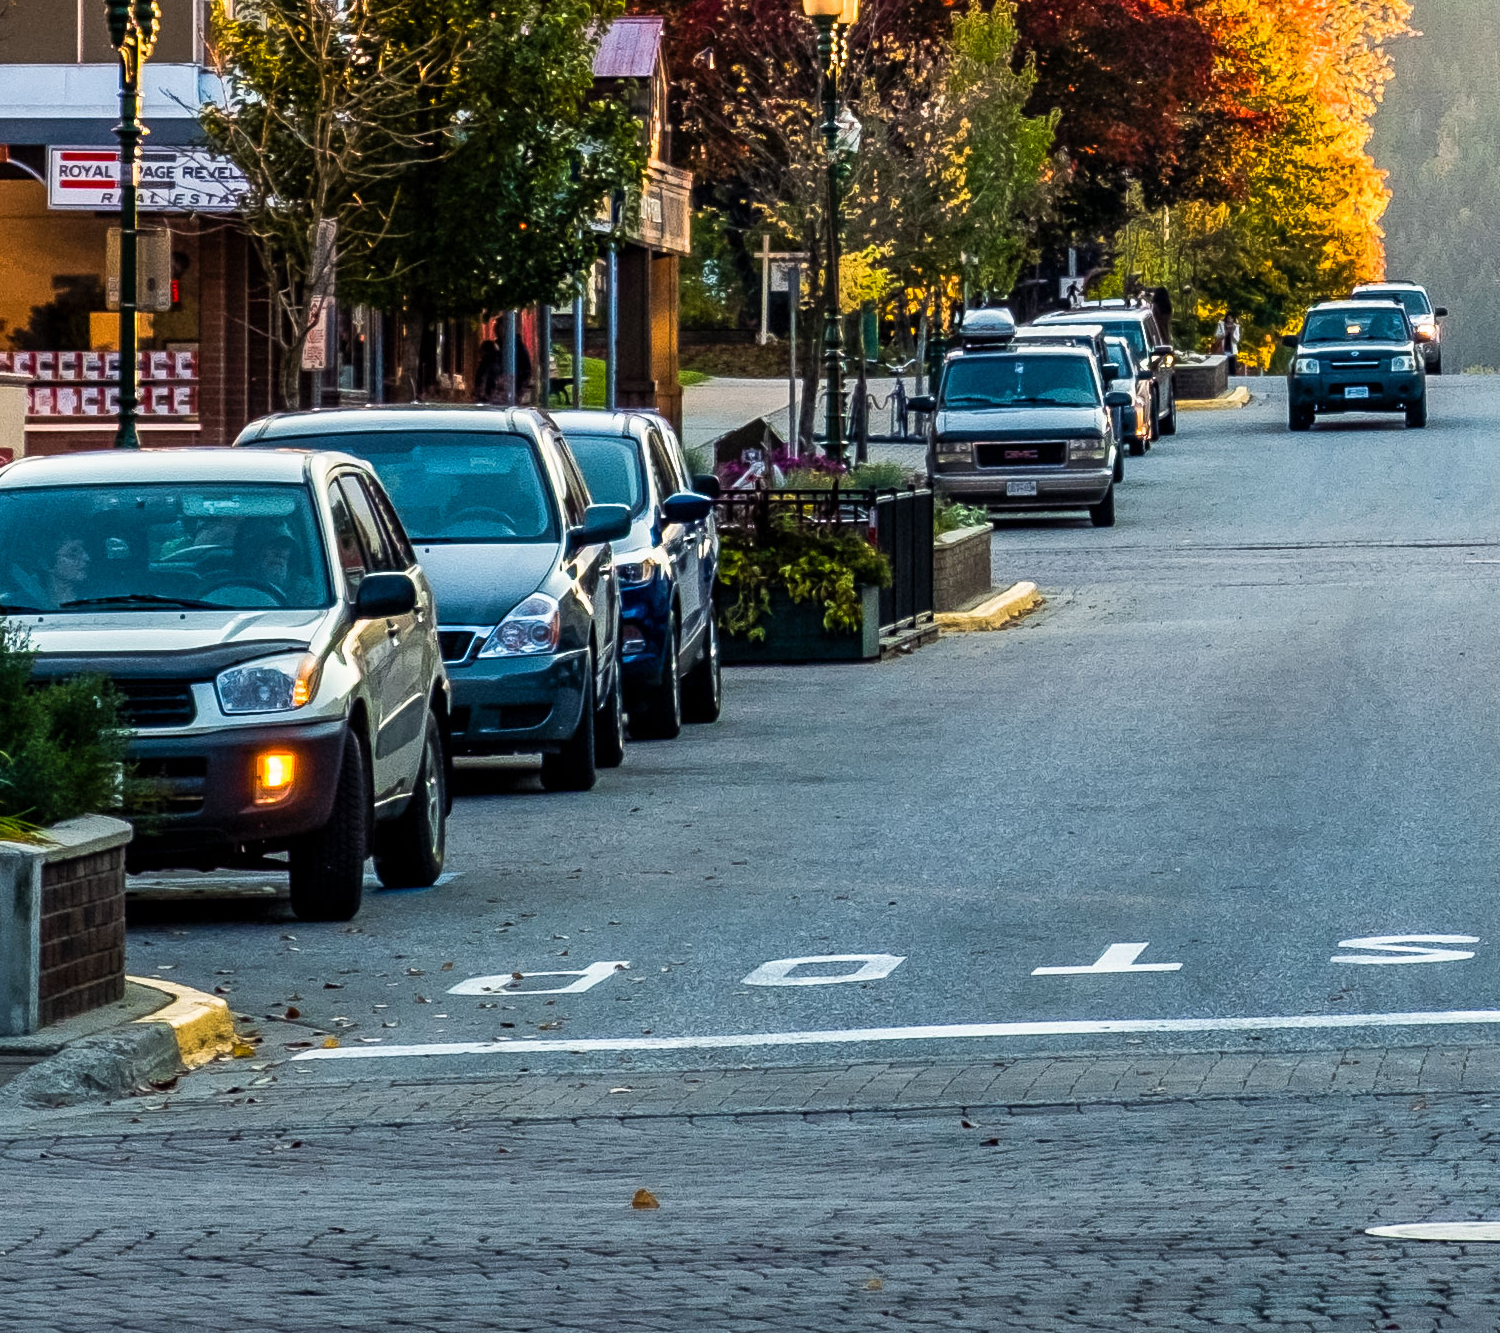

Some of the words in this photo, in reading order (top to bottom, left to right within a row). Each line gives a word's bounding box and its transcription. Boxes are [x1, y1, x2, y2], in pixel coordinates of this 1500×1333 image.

[59, 165, 114, 179] ROYAL
[100, 193, 162, 205] RAL
[446, 933, 1482, 999] STOP
